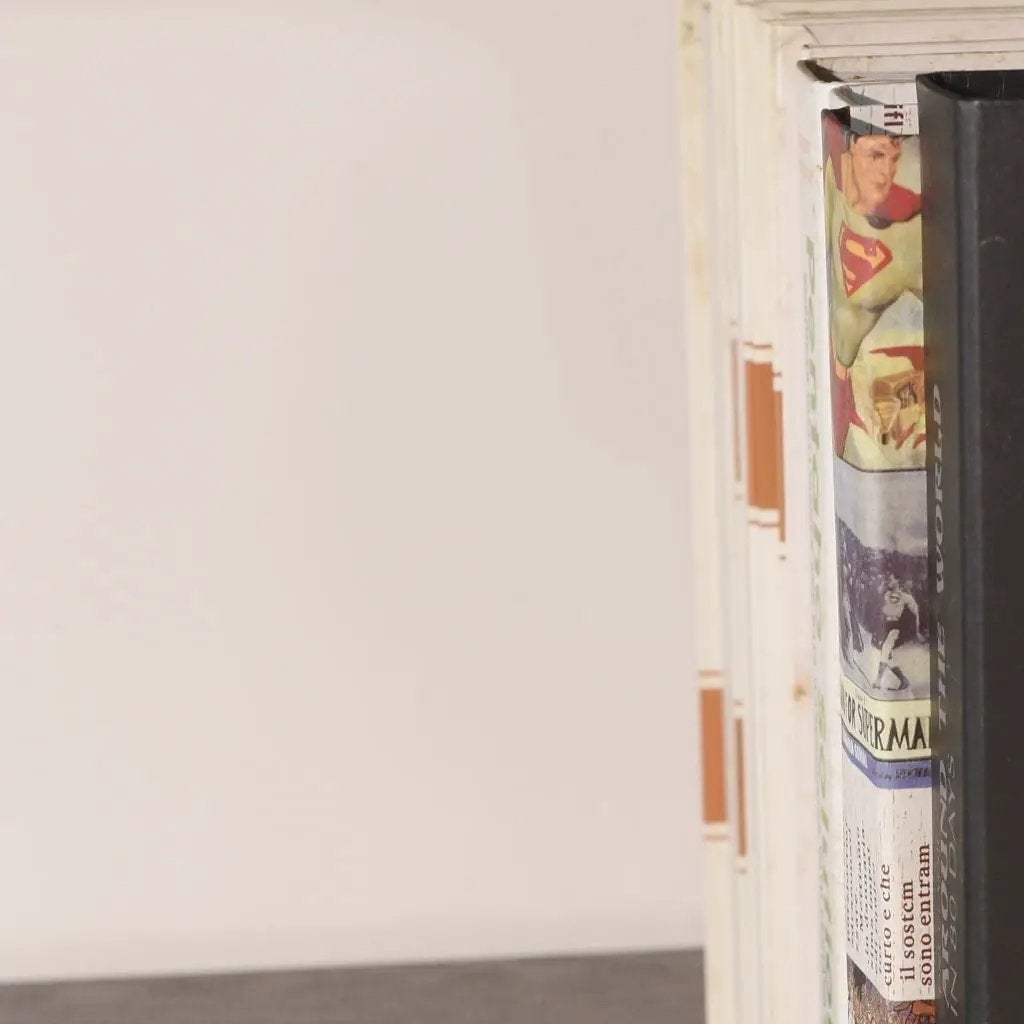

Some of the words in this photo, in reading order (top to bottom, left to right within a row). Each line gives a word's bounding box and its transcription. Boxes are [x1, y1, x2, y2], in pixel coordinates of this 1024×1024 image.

[933, 384, 945, 594] WORLD
[937, 621, 947, 731] THE
[948, 755, 957, 879] DAYS
[918, 843, 931, 927] entram
[899, 965, 915, 981] il
[921, 933, 932, 987] sono
